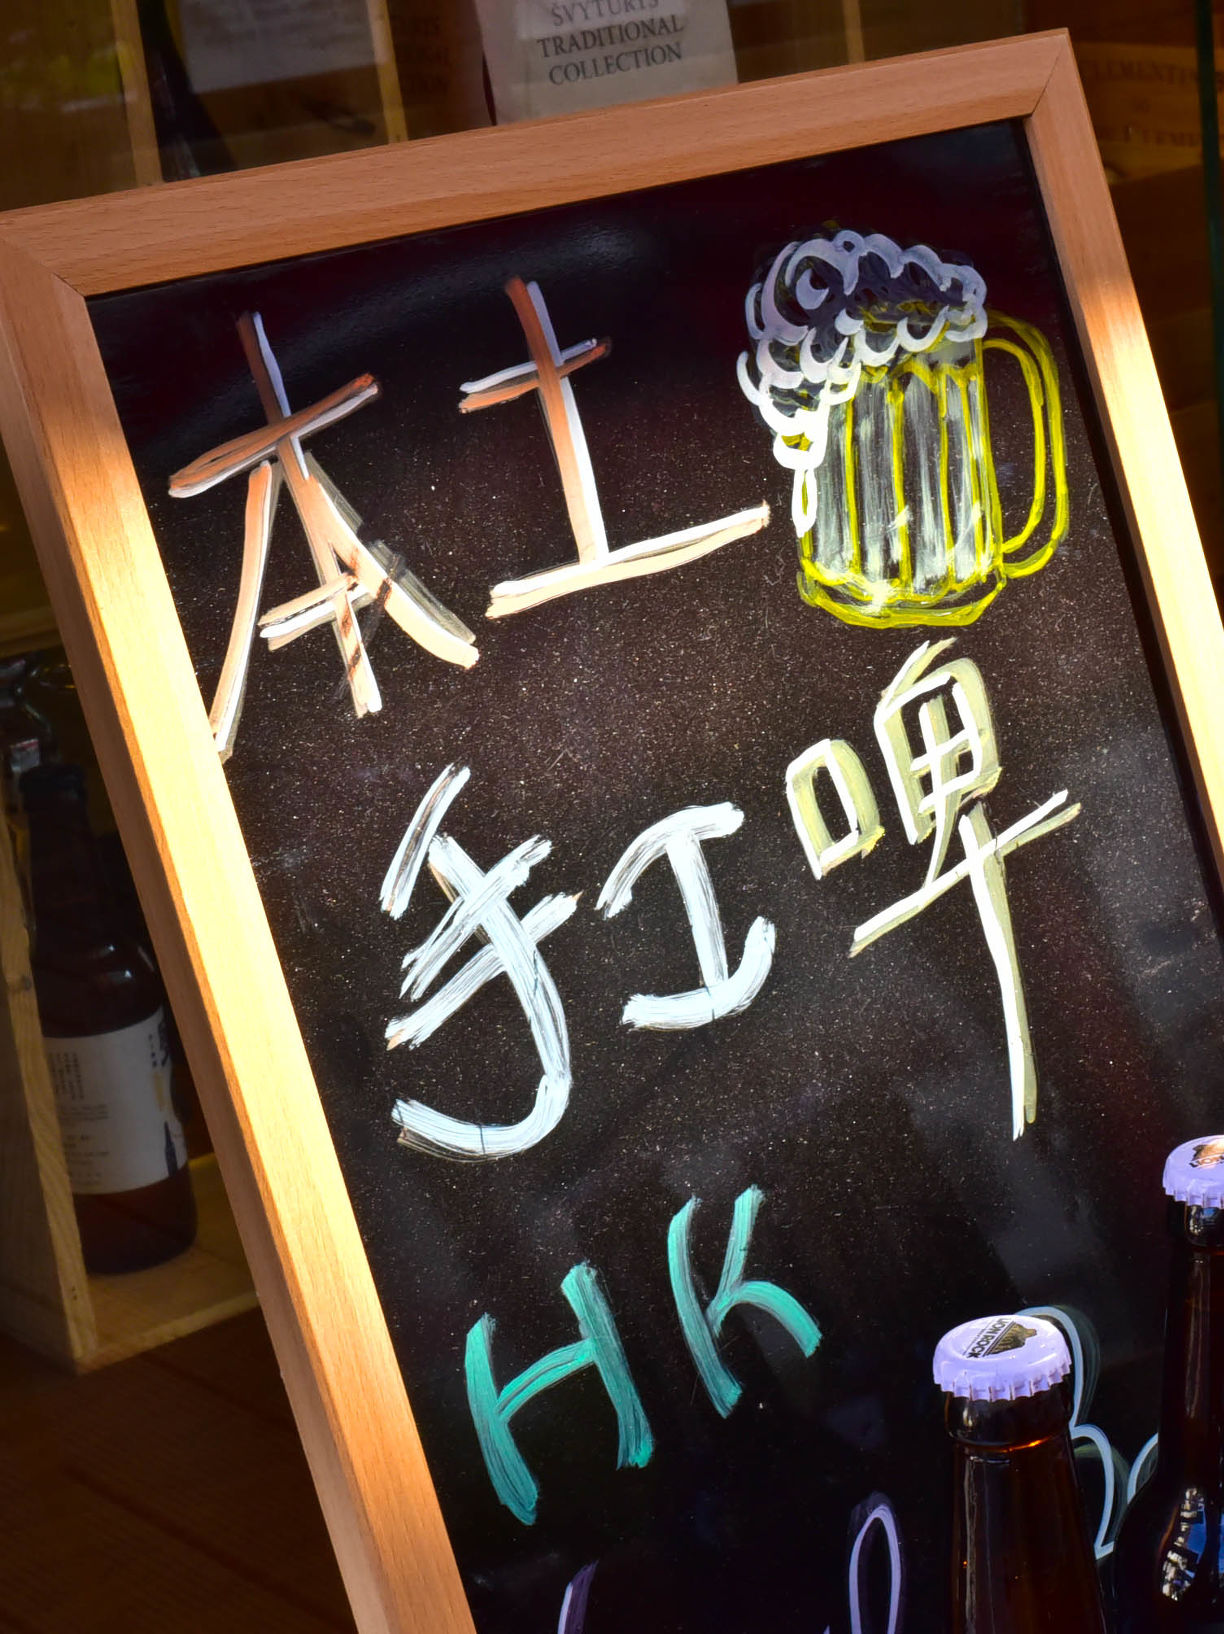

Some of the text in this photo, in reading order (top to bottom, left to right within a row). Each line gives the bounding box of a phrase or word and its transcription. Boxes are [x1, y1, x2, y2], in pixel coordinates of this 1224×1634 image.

[536, 14, 685, 58] TRADITIONAL
[548, 41, 683, 86] COLLECTION
[168, 274, 771, 761] 本土
[463, 1183, 823, 1526] HK
[967, 1332, 994, 1359] ROCK
